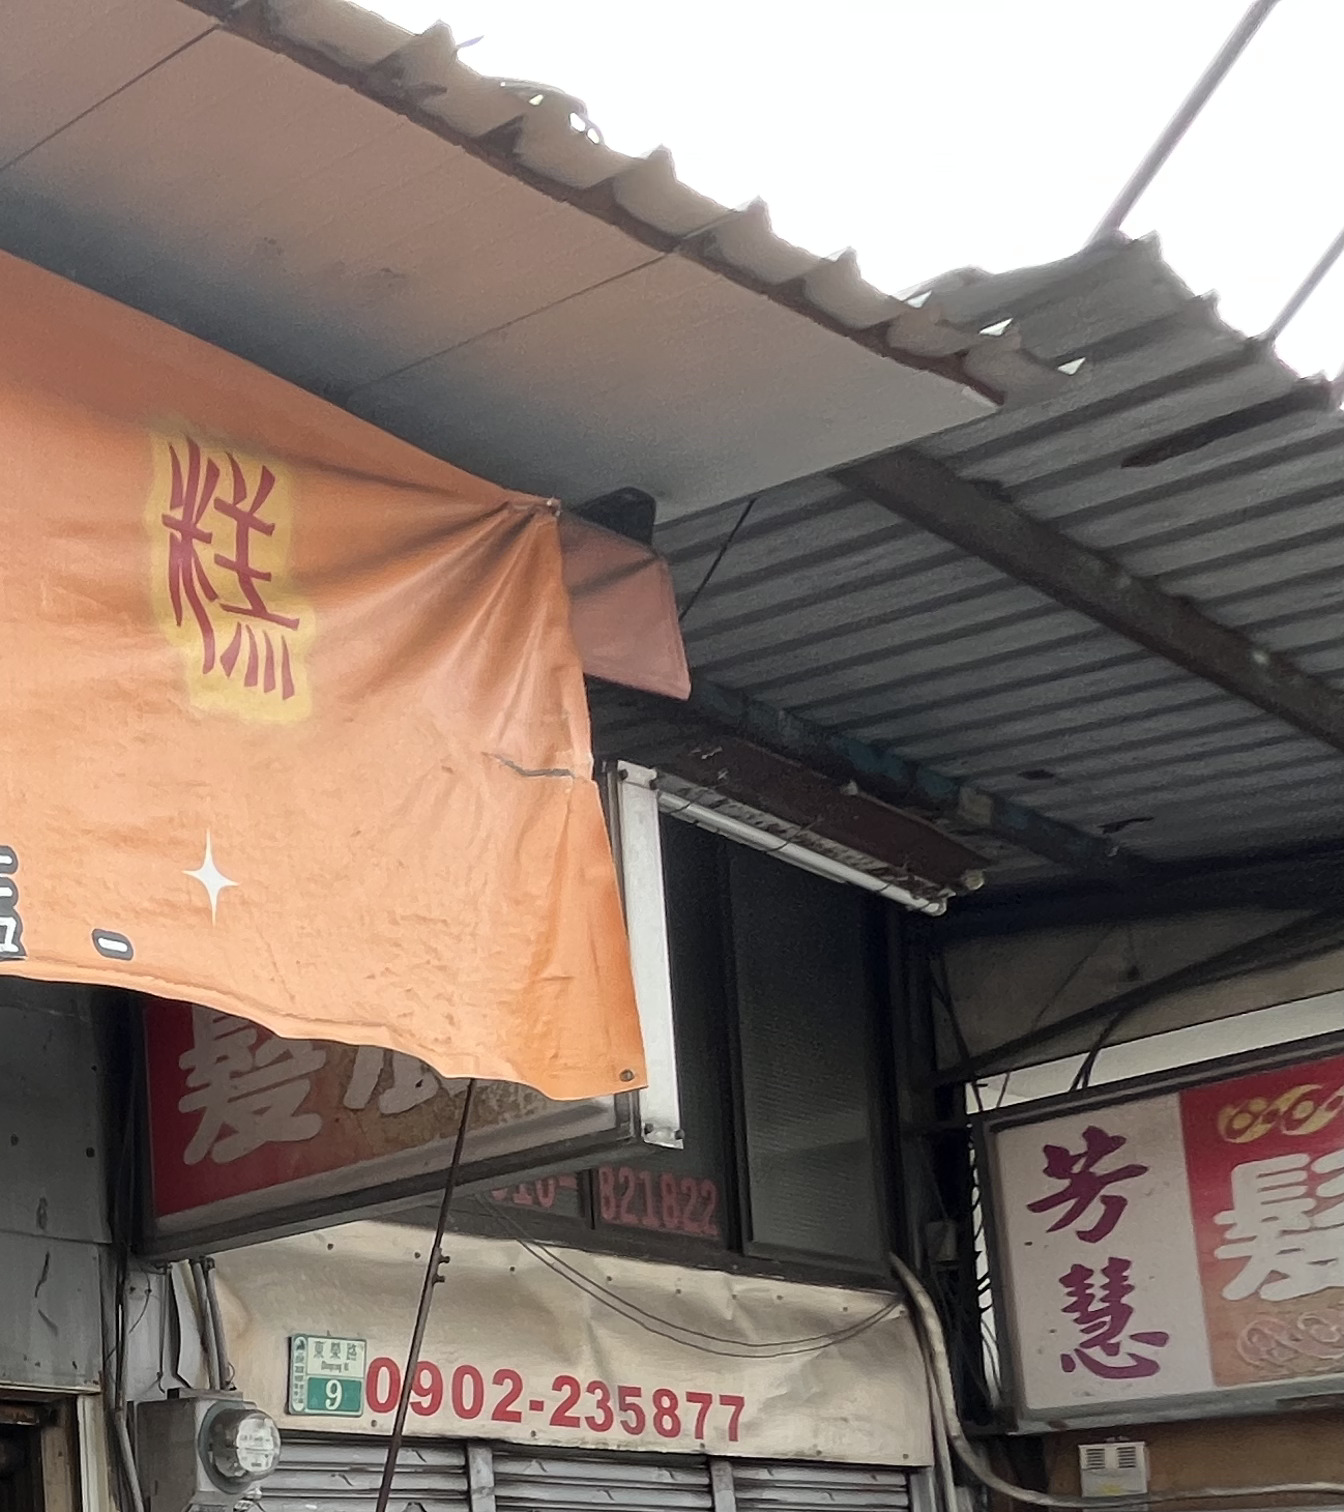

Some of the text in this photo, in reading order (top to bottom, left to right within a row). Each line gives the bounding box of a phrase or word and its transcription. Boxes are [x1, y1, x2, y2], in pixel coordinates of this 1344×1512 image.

[1026, 1124, 1171, 1380] 芳慧
[325, 1379, 343, 1410] 9
[365, 1356, 746, 1443] 0902-235877
